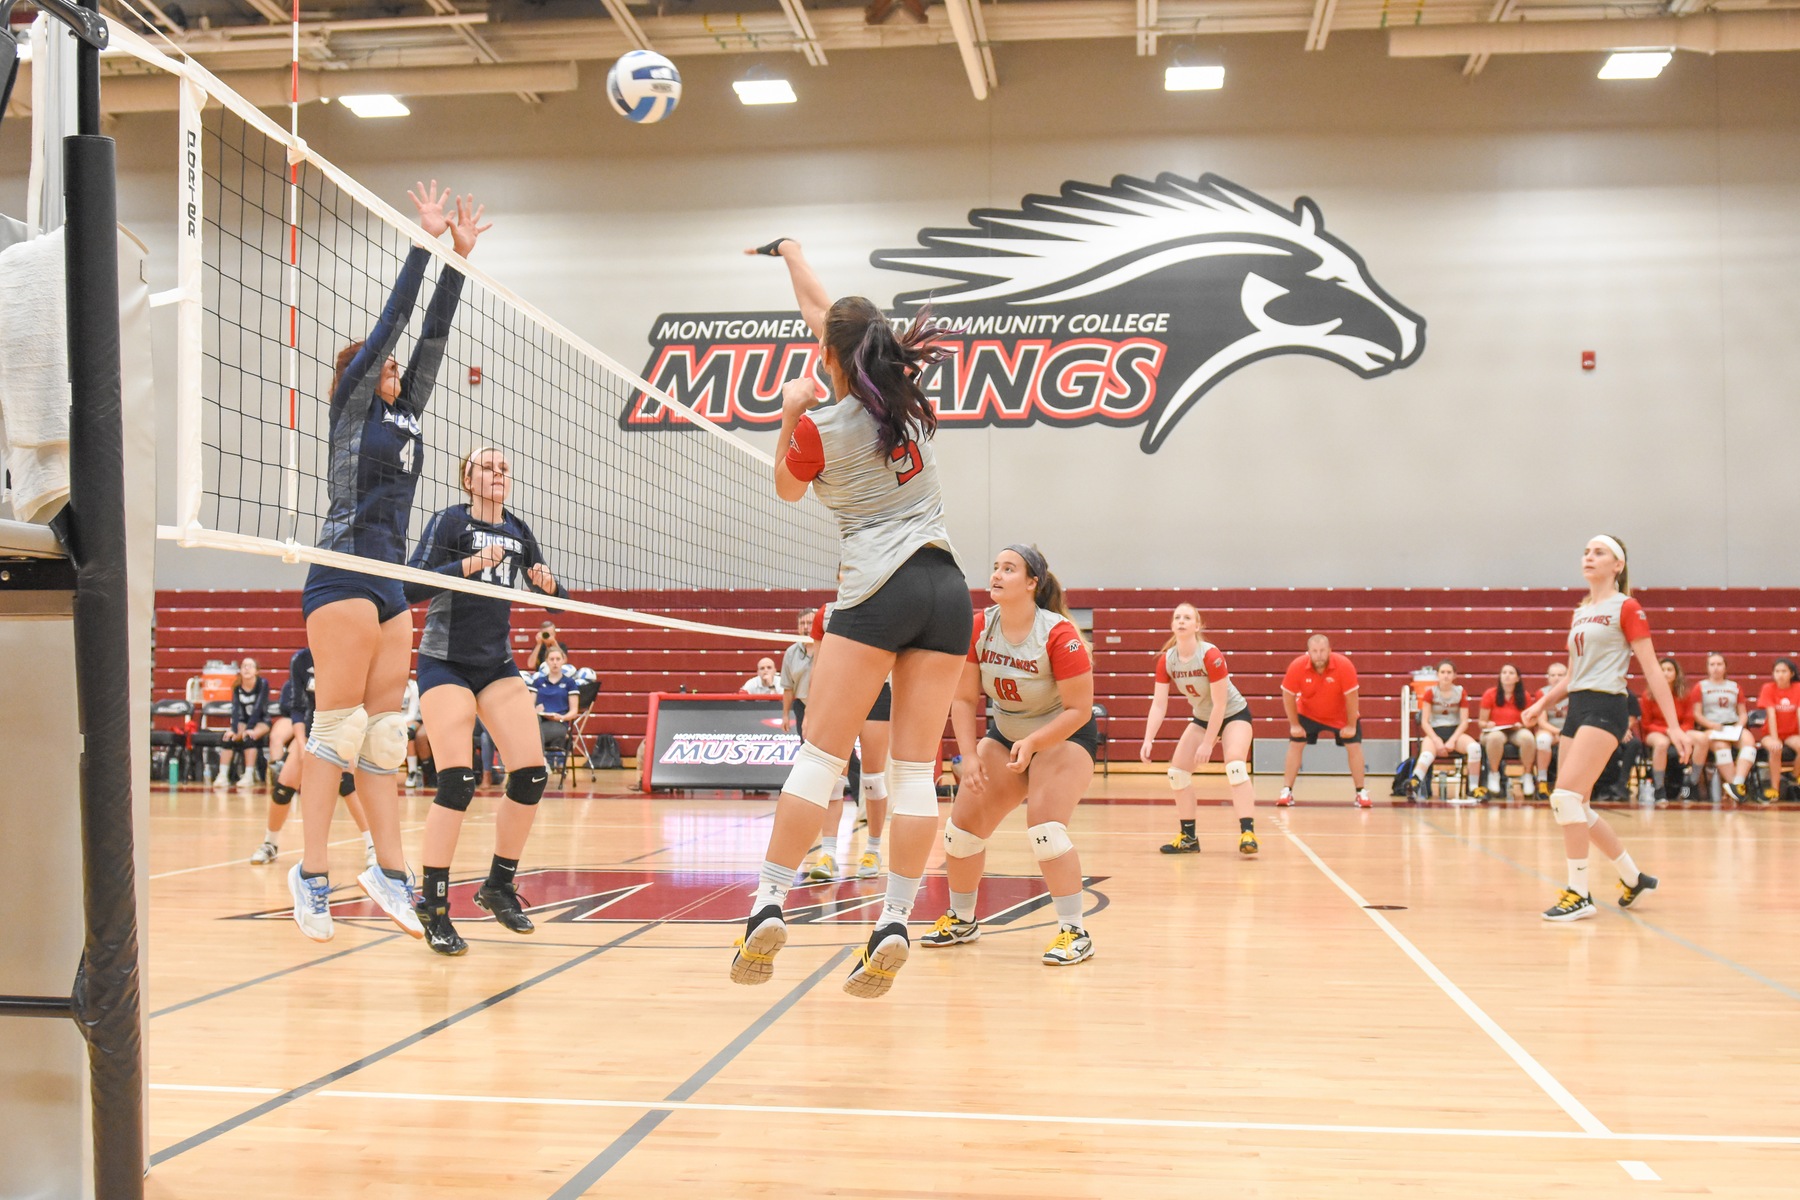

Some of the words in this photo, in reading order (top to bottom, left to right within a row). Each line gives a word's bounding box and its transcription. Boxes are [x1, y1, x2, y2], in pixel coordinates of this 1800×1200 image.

[1068, 313, 1170, 334] COLLEGE
[628, 337, 1167, 424] MUANGS
[399, 438, 415, 475] 4
[1574, 632, 1585, 657] 11
[980, 648, 1039, 674] MUSTANGS
[994, 677, 1023, 702] 18
[1186, 684, 1201, 697] 9
[660, 740, 801, 765] MUSTA
